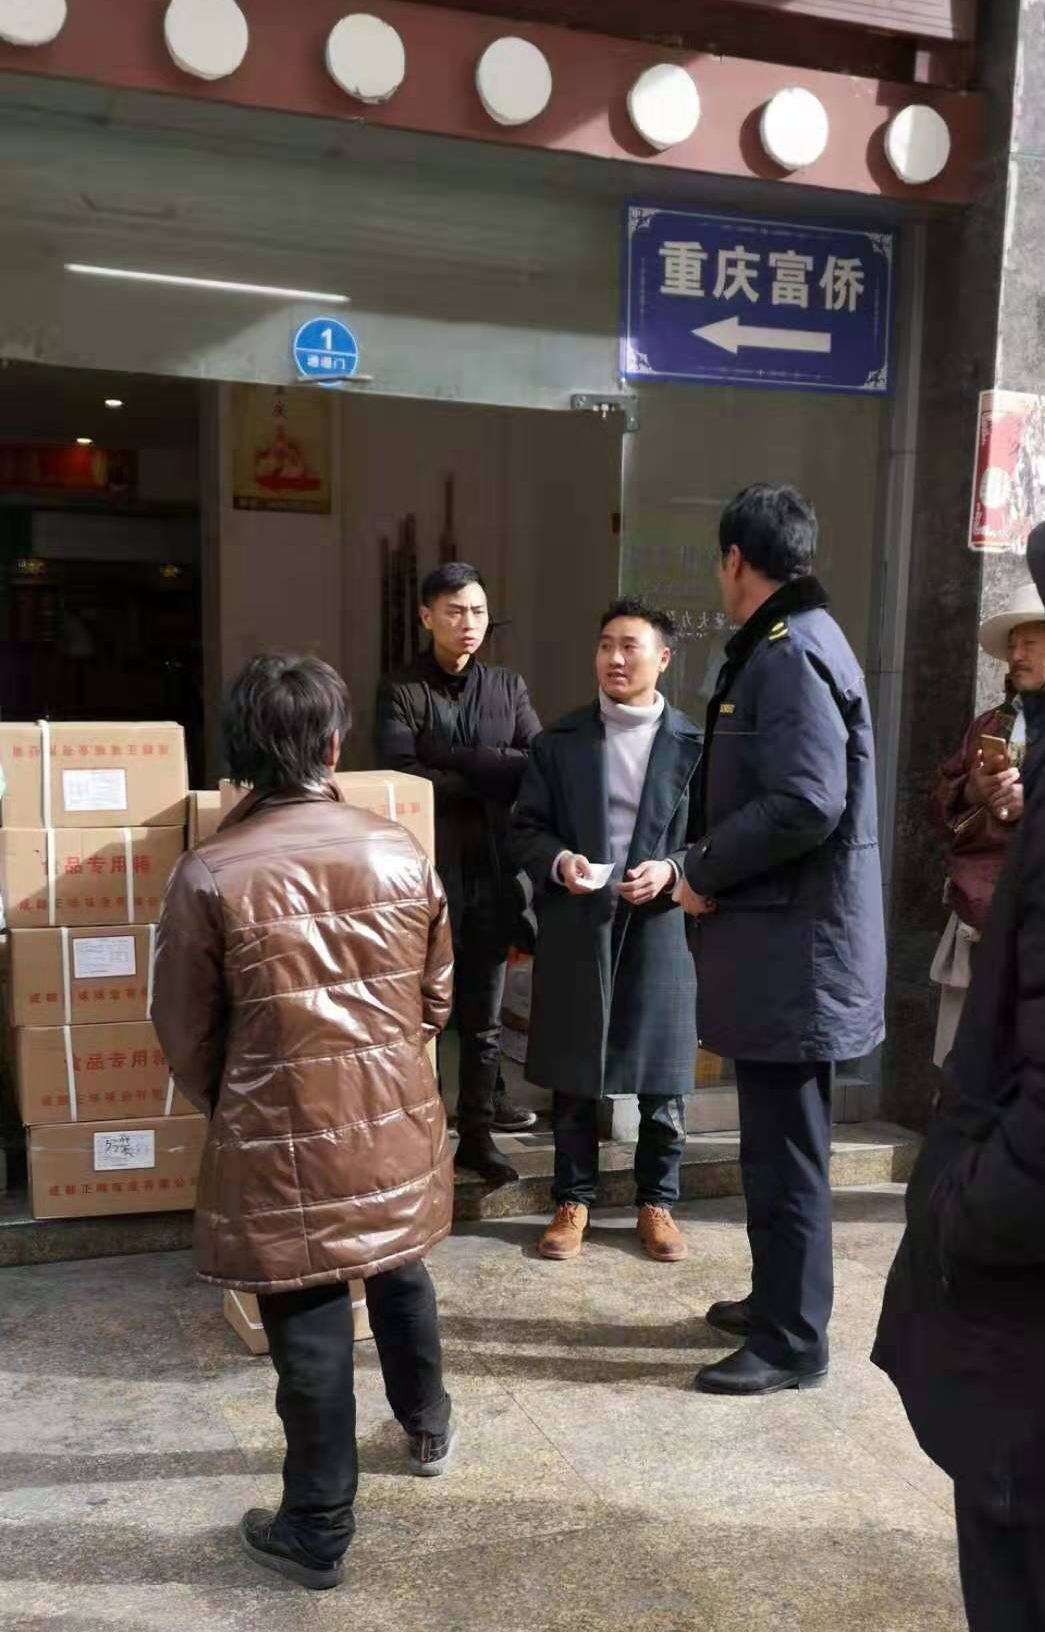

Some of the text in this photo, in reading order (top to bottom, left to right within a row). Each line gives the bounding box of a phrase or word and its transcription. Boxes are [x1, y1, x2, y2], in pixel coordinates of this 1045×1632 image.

[658, 240, 865, 312] 重庆富侨
[321, 327, 333, 350] 1
